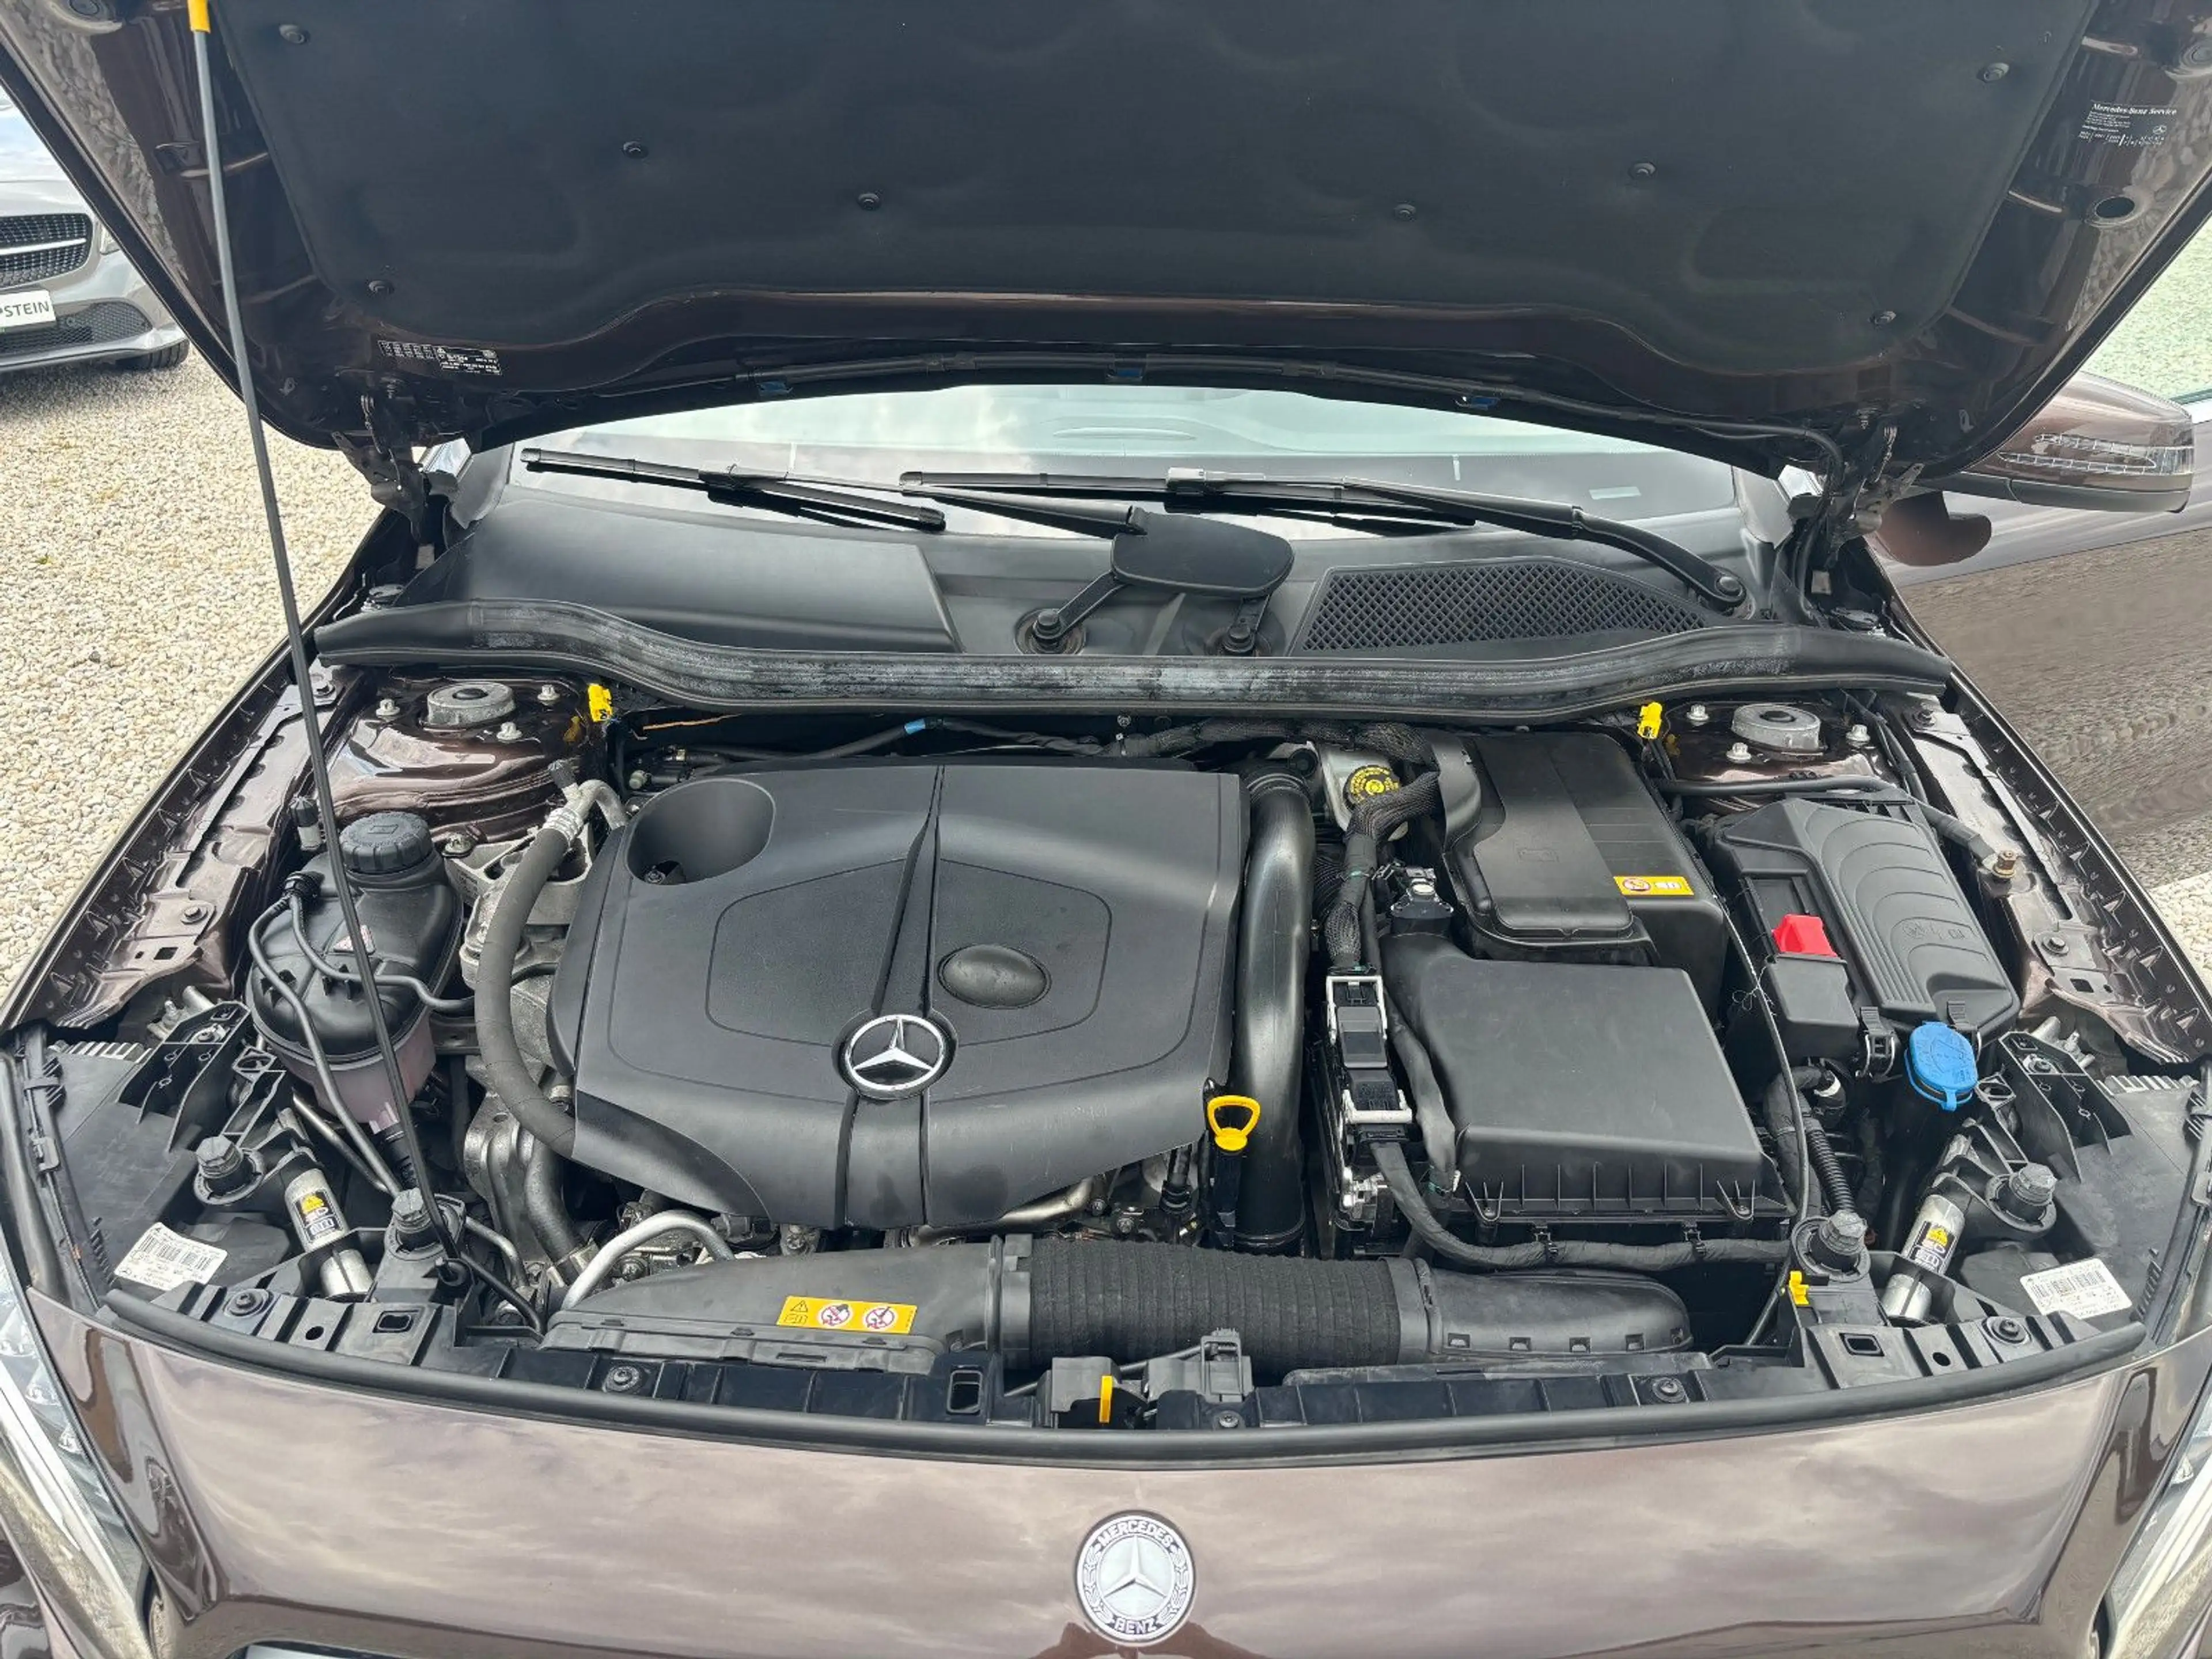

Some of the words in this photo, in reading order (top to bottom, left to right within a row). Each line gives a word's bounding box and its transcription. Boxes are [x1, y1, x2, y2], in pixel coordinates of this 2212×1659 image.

[2092, 104, 2147, 114] Mercedes-Benz
[1098, 1521, 1174, 1547] MERCEDES
[1114, 1617, 1158, 1634] BENZ
